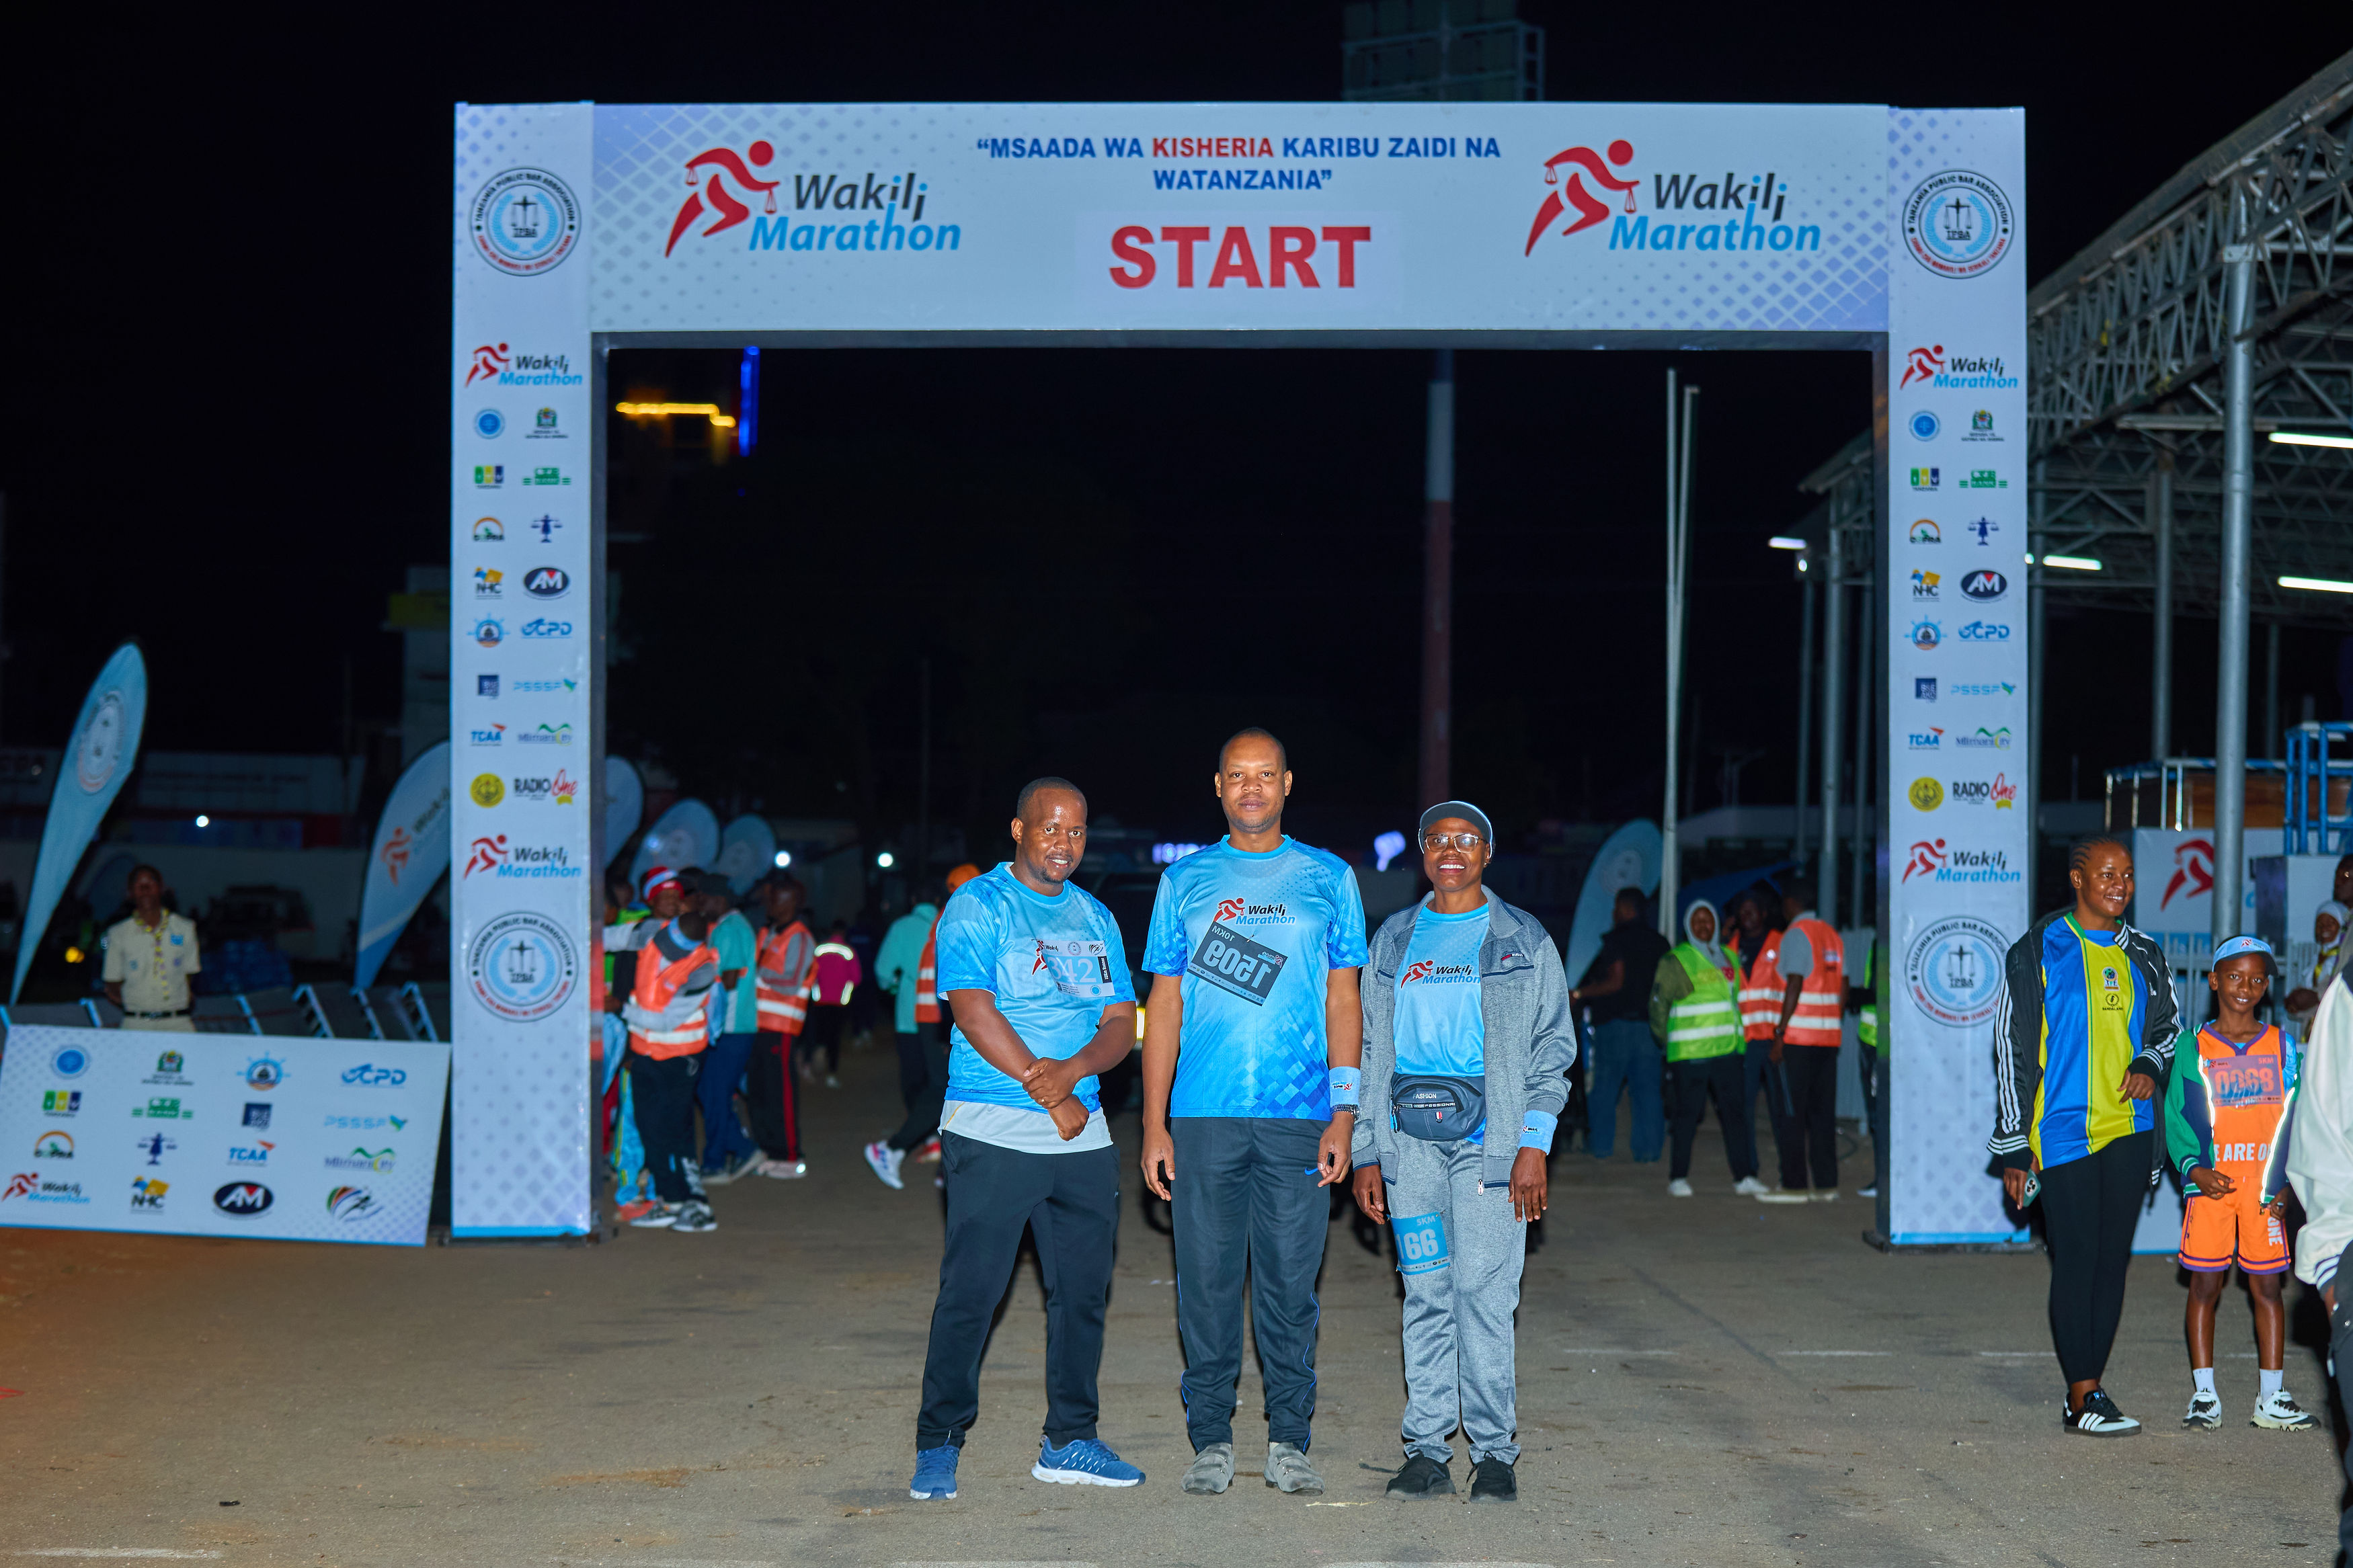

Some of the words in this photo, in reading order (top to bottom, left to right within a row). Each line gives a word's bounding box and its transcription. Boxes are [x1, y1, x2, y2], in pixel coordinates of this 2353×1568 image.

[1105, 138, 1144, 159] WA
[1152, 138, 1274, 159] KISHERIA
[1283, 138, 1380, 159] KARIBU
[1388, 138, 1456, 159] ZAIDI
[1465, 138, 1501, 159] NA
[1907, 188, 1930, 224] TANZANIA
[1929, 175, 1957, 191] PUBLIC
[1958, 175, 1974, 183] BAR
[1975, 179, 2009, 224] ASSOCIATION
[748, 203, 961, 251] Marathon
[1608, 203, 1821, 251] Marathon
[1109, 225, 1371, 289] START
[498, 368, 583, 386] Marathon
[1933, 369, 2019, 388] Marathon
[530, 570, 563, 590] AM
[1966, 573, 2001, 593] AM
[1913, 585, 1940, 597] NHC
[471, 731, 503, 743] TCAA
[1908, 733, 1940, 746] TCAA
[514, 778, 552, 794] RADIO
[1952, 781, 1990, 798] RADIO
[497, 860, 582, 878] Marathon
[1936, 864, 2021, 882] Marathon
[1236, 912, 1296, 925] Marathon
[1931, 922, 1960, 936] PUBLIC
[1422, 971, 1480, 985] Marathon
[229, 1147, 268, 1161] TCAA
[2223, 1143, 2256, 1162] ARE
[221, 1185, 266, 1208] AM
[2268, 1216, 2284, 1246] ONE
